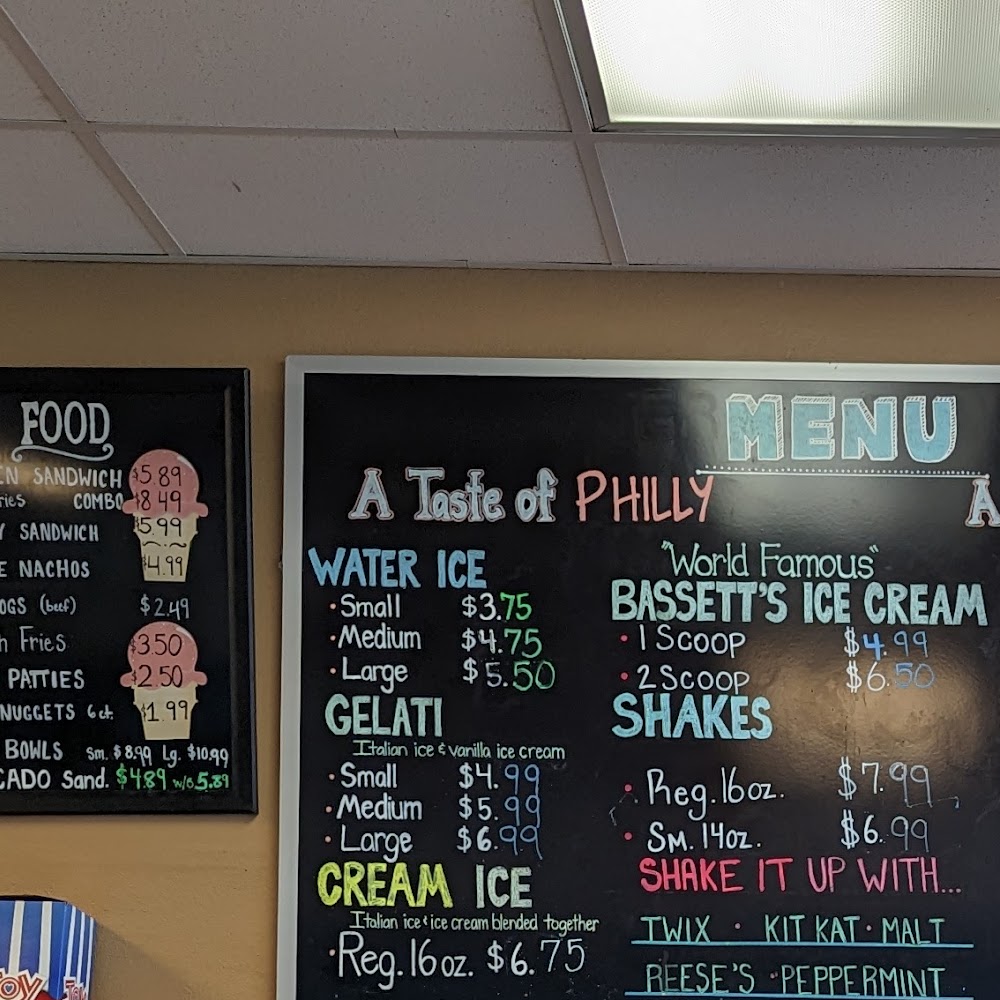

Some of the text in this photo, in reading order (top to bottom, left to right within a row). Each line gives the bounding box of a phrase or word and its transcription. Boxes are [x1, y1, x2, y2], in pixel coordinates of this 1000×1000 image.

[21, 401, 110, 445] FOOD
[726, 393, 957, 463] MENU
[33, 467, 122, 489] SANDWICH
[348, 467, 714, 523] A Taste of PHILLY
[73, 493, 123, 510] COMBO
[20, 522, 99, 542] SANDWICH
[19, 559, 90, 578] NACHOS
[308, 547, 487, 589] WATER ICE
[341, 592, 533, 621] Small $3.75
[610, 579, 989, 627] BASSETT'S ICE CREAM
[19, 625, 66, 652] Fries
[338, 622, 543, 659] Medium $4.75
[844, 626, 928, 661] $4.99
[8, 668, 85, 690] PATTIES
[342, 656, 556, 694] Large $5.50
[846, 660, 935, 694] $6.50
[0, 703, 76, 721] NUGGETS
[324, 693, 443, 737] GELATI
[610, 692, 773, 740] SHAKES
[5, 739, 63, 761] BOWLS
[352, 739, 566, 760] Italian cream
[61, 767, 109, 790] Sand.
[340, 762, 541, 797] Small $4.99
[838, 756, 932, 808] $7.99
[336, 793, 542, 829] Medium $5.99
[340, 824, 543, 863] Large $6.99
[841, 809, 929, 852] $6.99
[316, 861, 533, 909] CREAM ICE
[639, 857, 962, 894] SHAKE IT UP WITH...
[350, 911, 600, 938] Italian blended together
[640, 914, 945, 944] TWIX KIT KAT MALT
[487, 938, 586, 976] $6.75
[646, 962, 946, 998] REESE'S PEPPERMINT
